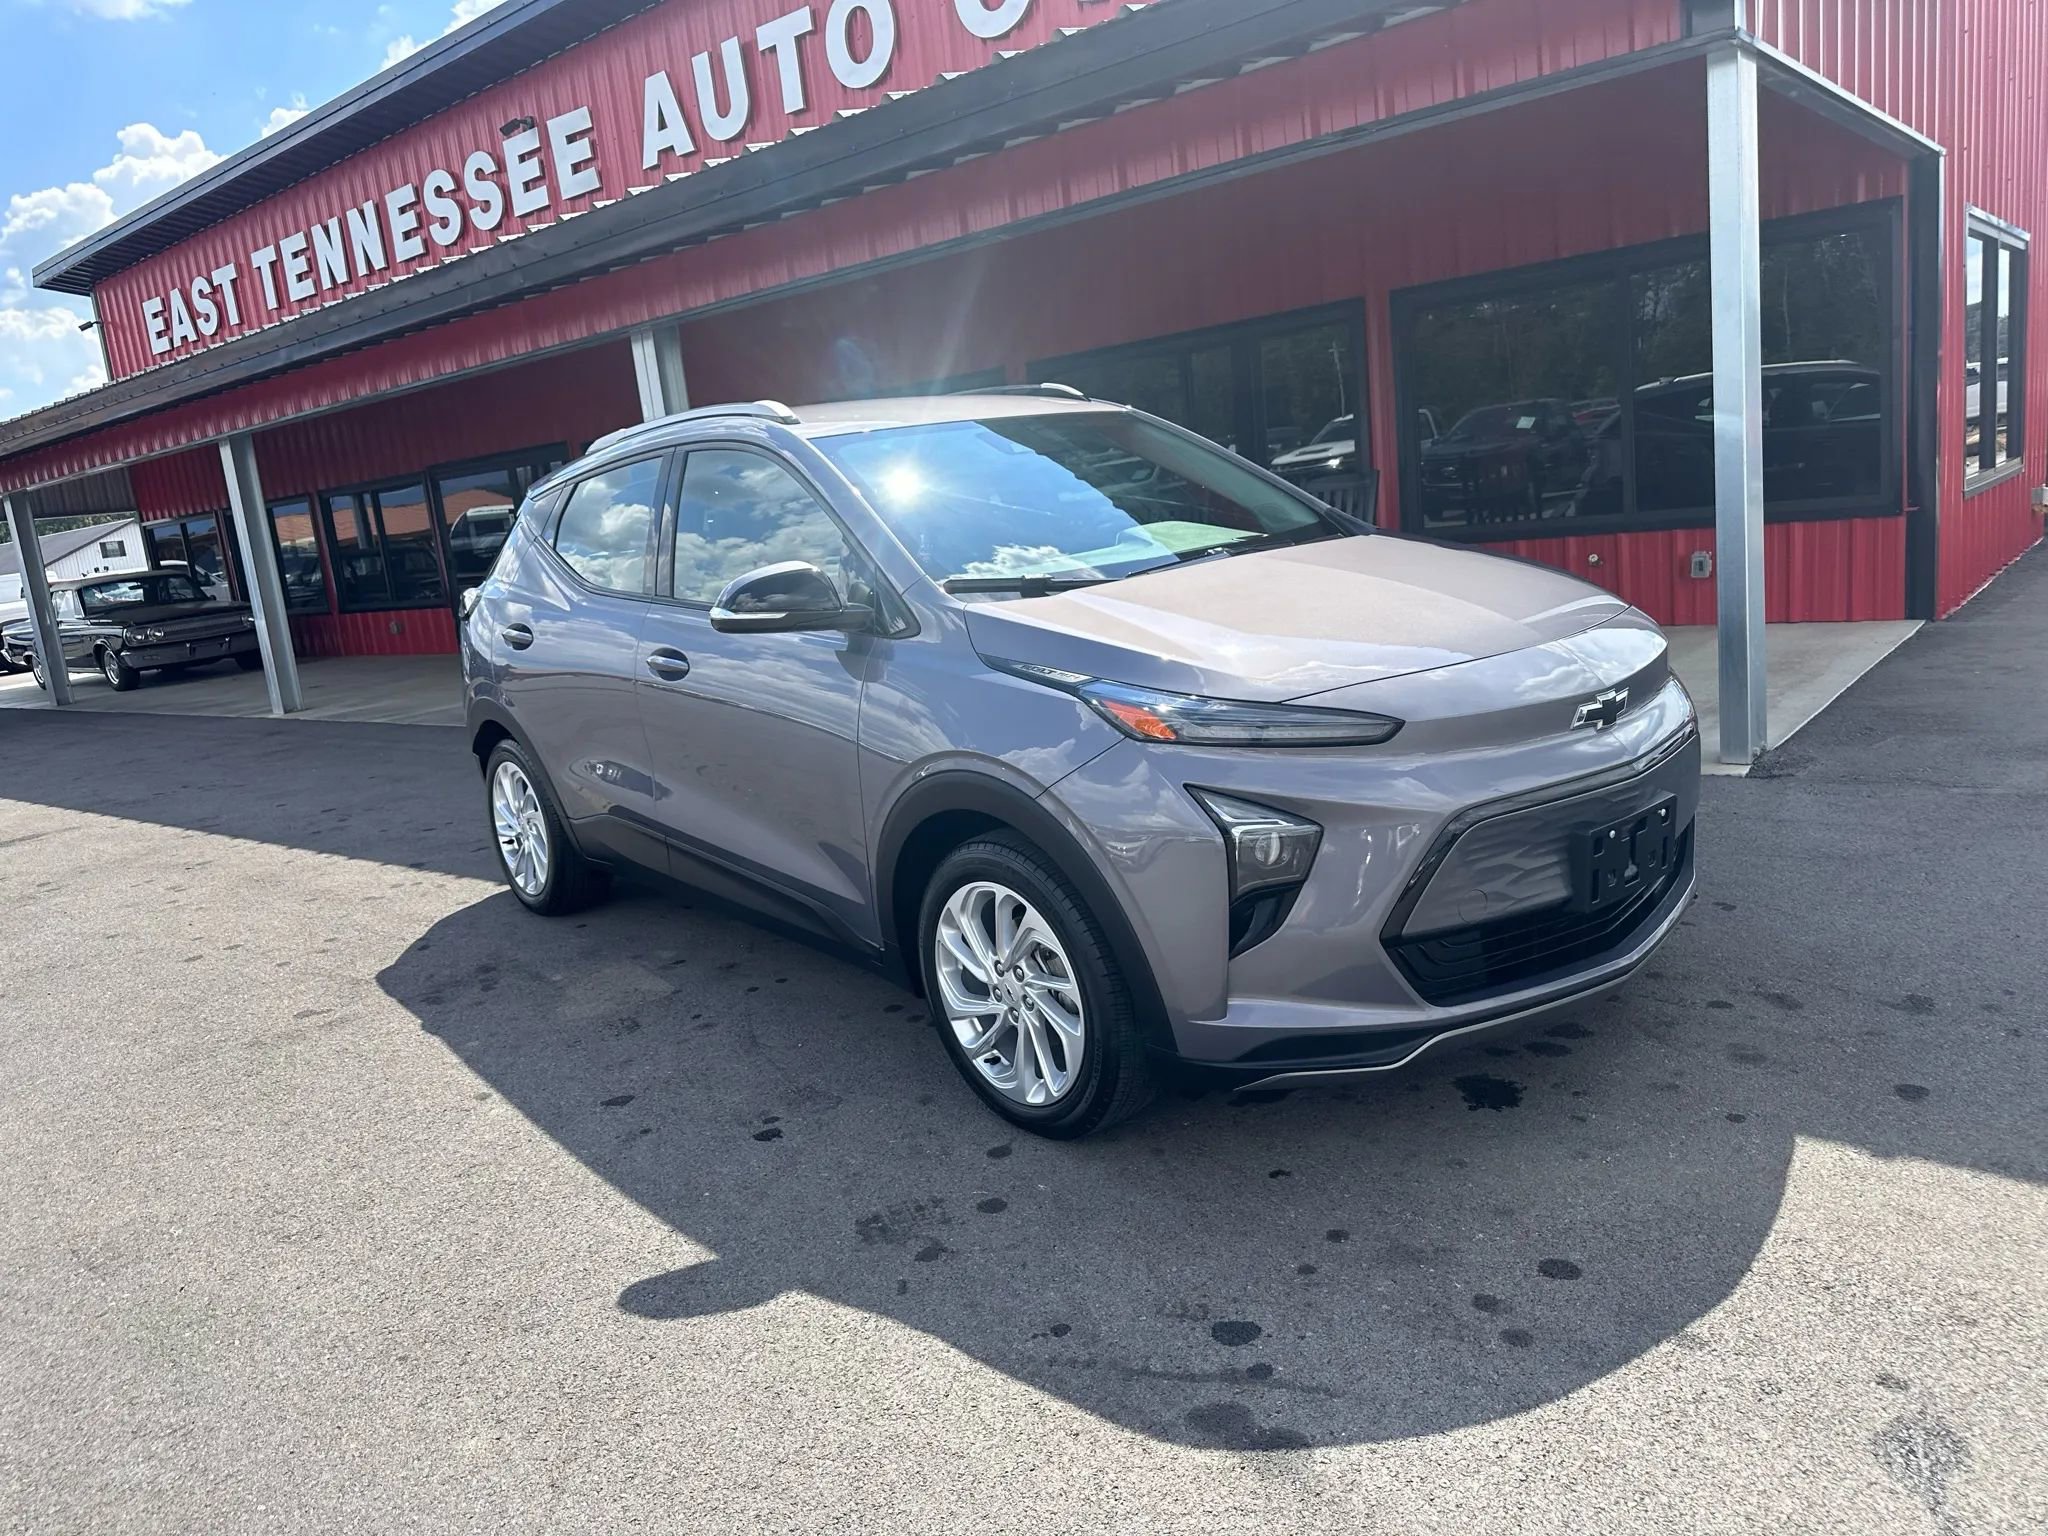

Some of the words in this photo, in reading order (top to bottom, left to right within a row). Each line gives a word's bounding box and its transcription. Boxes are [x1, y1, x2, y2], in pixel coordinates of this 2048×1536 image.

[142, 263, 242, 355] EAST
[251, 106, 602, 309] TENNESSEE
[642, 0, 896, 170] AUTO
